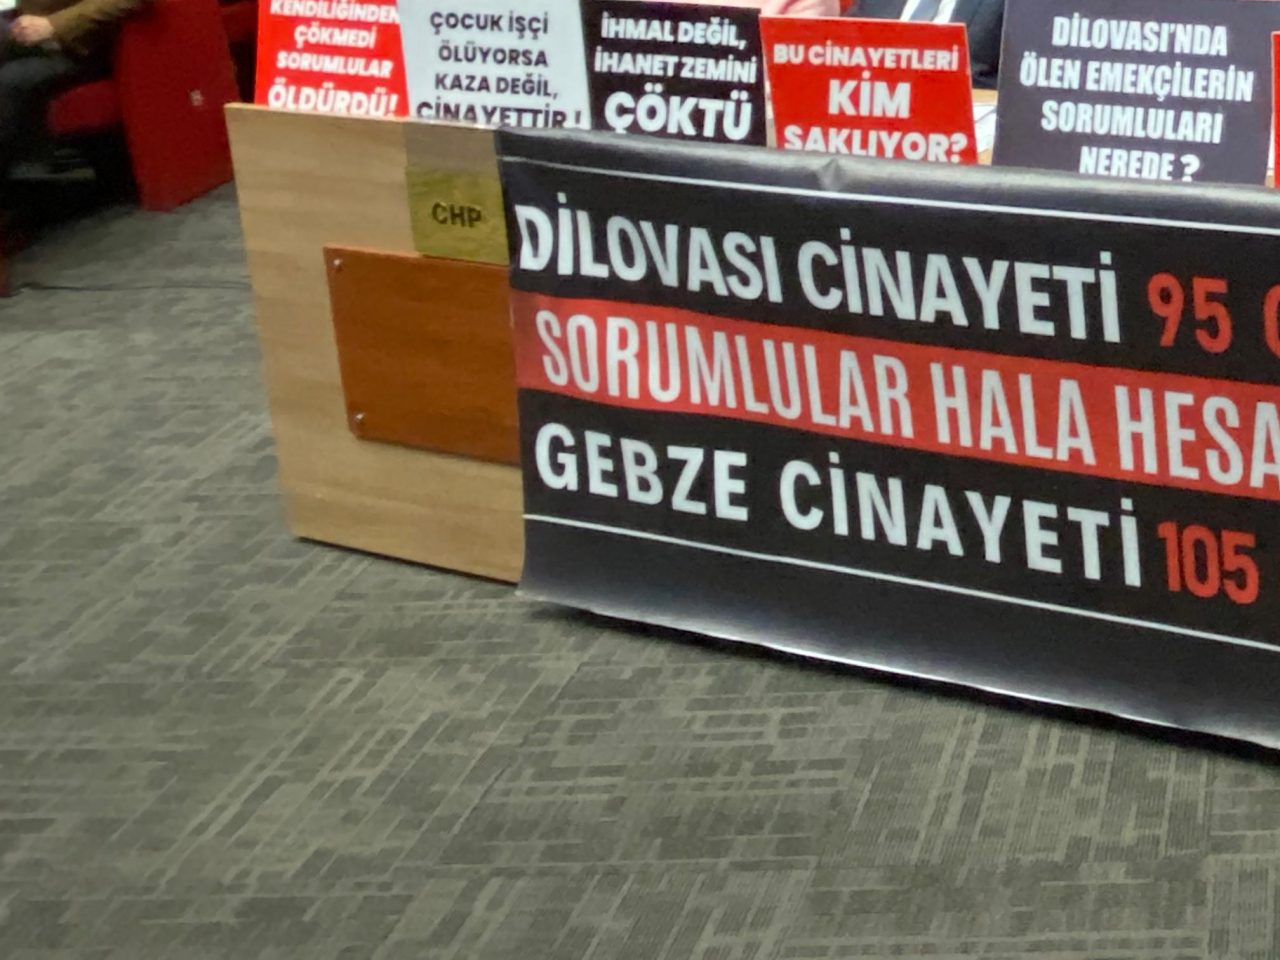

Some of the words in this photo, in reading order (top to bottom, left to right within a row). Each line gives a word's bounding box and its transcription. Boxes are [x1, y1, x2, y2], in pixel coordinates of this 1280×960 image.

[294, 24, 377, 48] ÇÖKMEDİ
[430, 11, 503, 35] ÇOCUK
[508, 10, 549, 39] İŞÇİ
[601, 11, 674, 42] İHMAL
[678, 16, 747, 50] DEĞİL,
[1052, 12, 1228, 56] DİLOVASI'NDA
[276, 51, 393, 78] SORUMLULAR
[438, 40, 549, 67] ÖLÜYORSA
[594, 46, 681, 78] İHANET
[681, 54, 757, 85] ZEMİNİ
[773, 44, 804, 64] BU
[808, 40, 959, 71] CİNAYETLERİ
[435, 73, 490, 93] KAZA
[496, 74, 559, 100] DEĞİL,
[828, 71, 911, 119] KİM
[1019, 51, 1081, 89] ÖLEN
[1085, 60, 1254, 102] EMEKÇİLERİN
[267, 78, 398, 117] ÖLDÜRDÜ!
[604, 82, 752, 140] ÇÖKTÜ
[1041, 100, 1223, 144] SORUMLULARI
[784, 124, 967, 163] SAKLIYOR?
[1079, 145, 1175, 181] NEREDE
[432, 201, 483, 228] CHP
[514, 192, 783, 303] DİLOVASI
[797, 227, 1120, 342] CİNAYETİ
[1148, 272, 1233, 354] 95
[535, 309, 912, 439] SORUMLULAR
[930, 362, 1096, 466] HALA
[535, 422, 748, 521] GEBZE
[780, 451, 1142, 588] CİNAYETİ
[1158, 521, 1260, 605] 105
